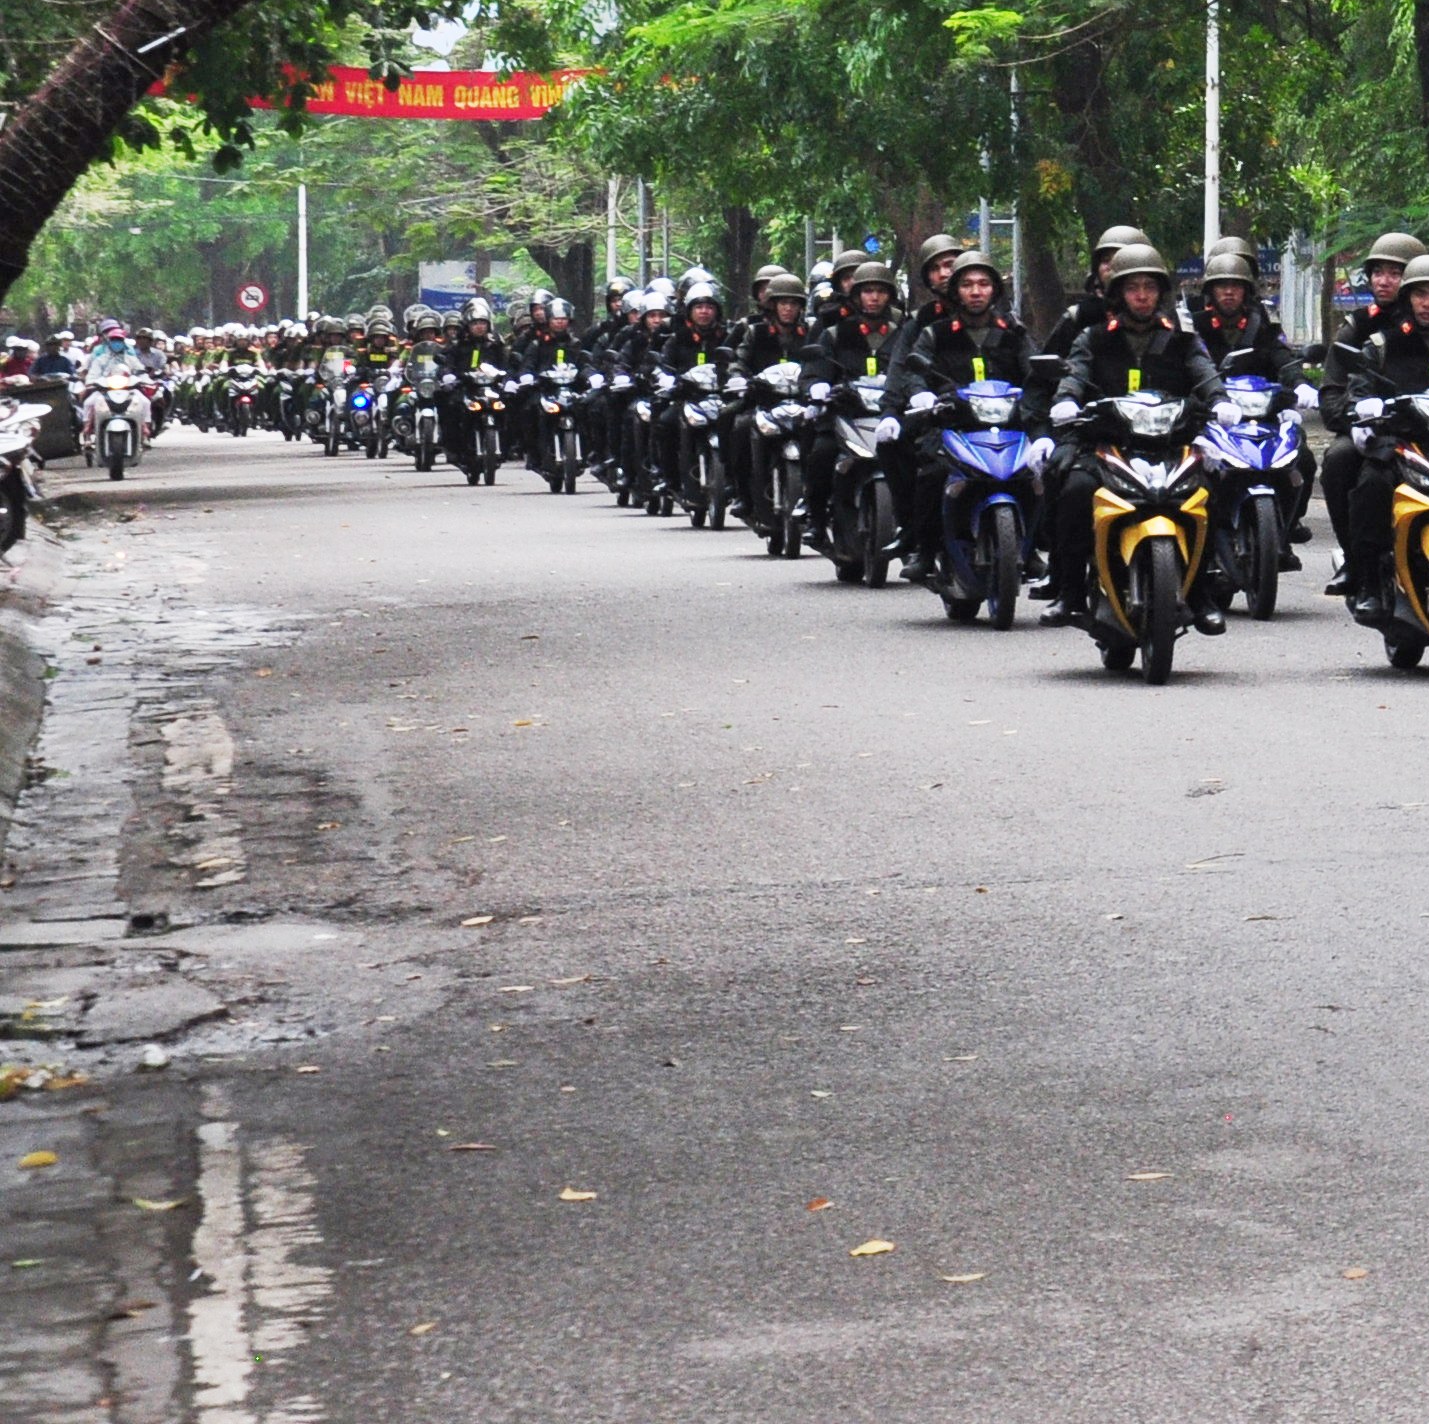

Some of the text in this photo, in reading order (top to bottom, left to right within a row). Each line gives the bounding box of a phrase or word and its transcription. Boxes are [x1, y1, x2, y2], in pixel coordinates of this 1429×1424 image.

[346, 77, 384, 109] VIỆT
[398, 84, 444, 107] NAM
[454, 83, 520, 109] QUANG
[529, 84, 568, 108] VIN
